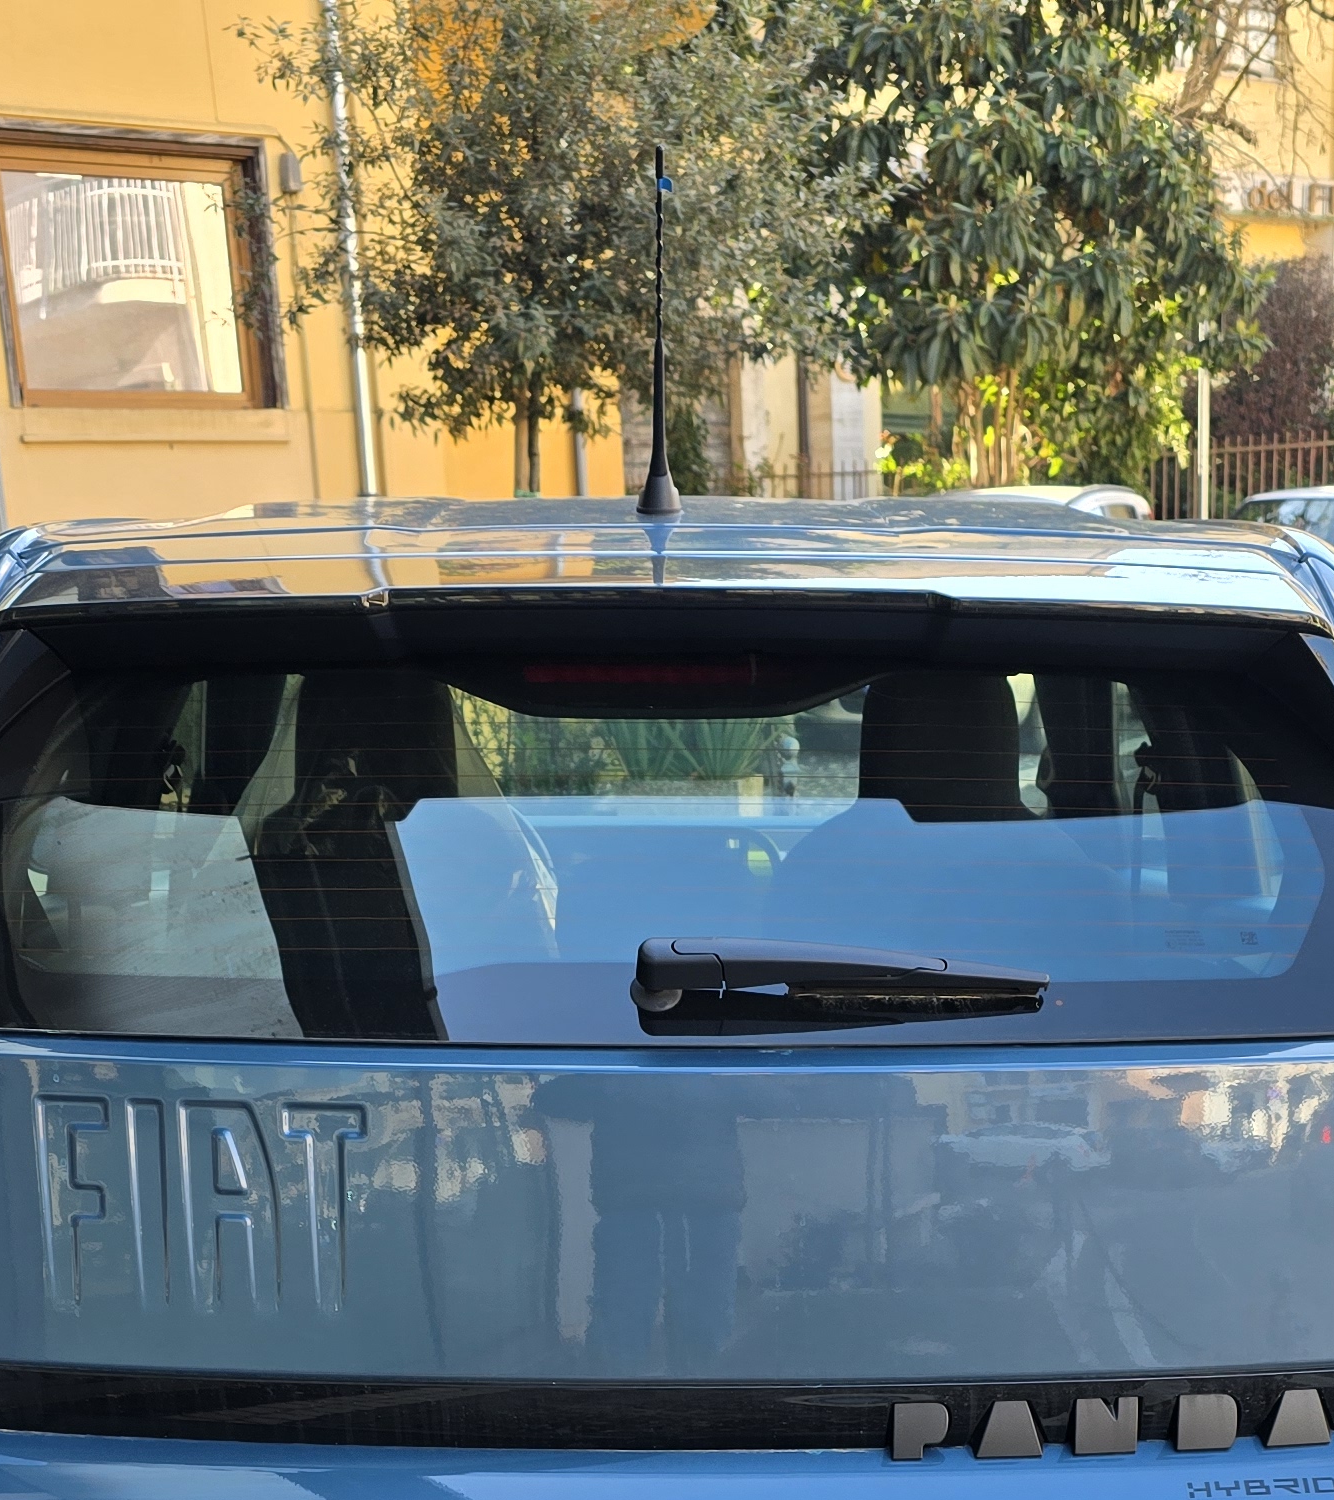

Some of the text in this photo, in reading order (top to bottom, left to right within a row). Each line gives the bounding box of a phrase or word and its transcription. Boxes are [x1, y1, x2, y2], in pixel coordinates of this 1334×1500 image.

[1248, 179, 1294, 212] del
[33, 1091, 369, 1312] FIAT
[891, 1388, 1333, 1461] PANDA
